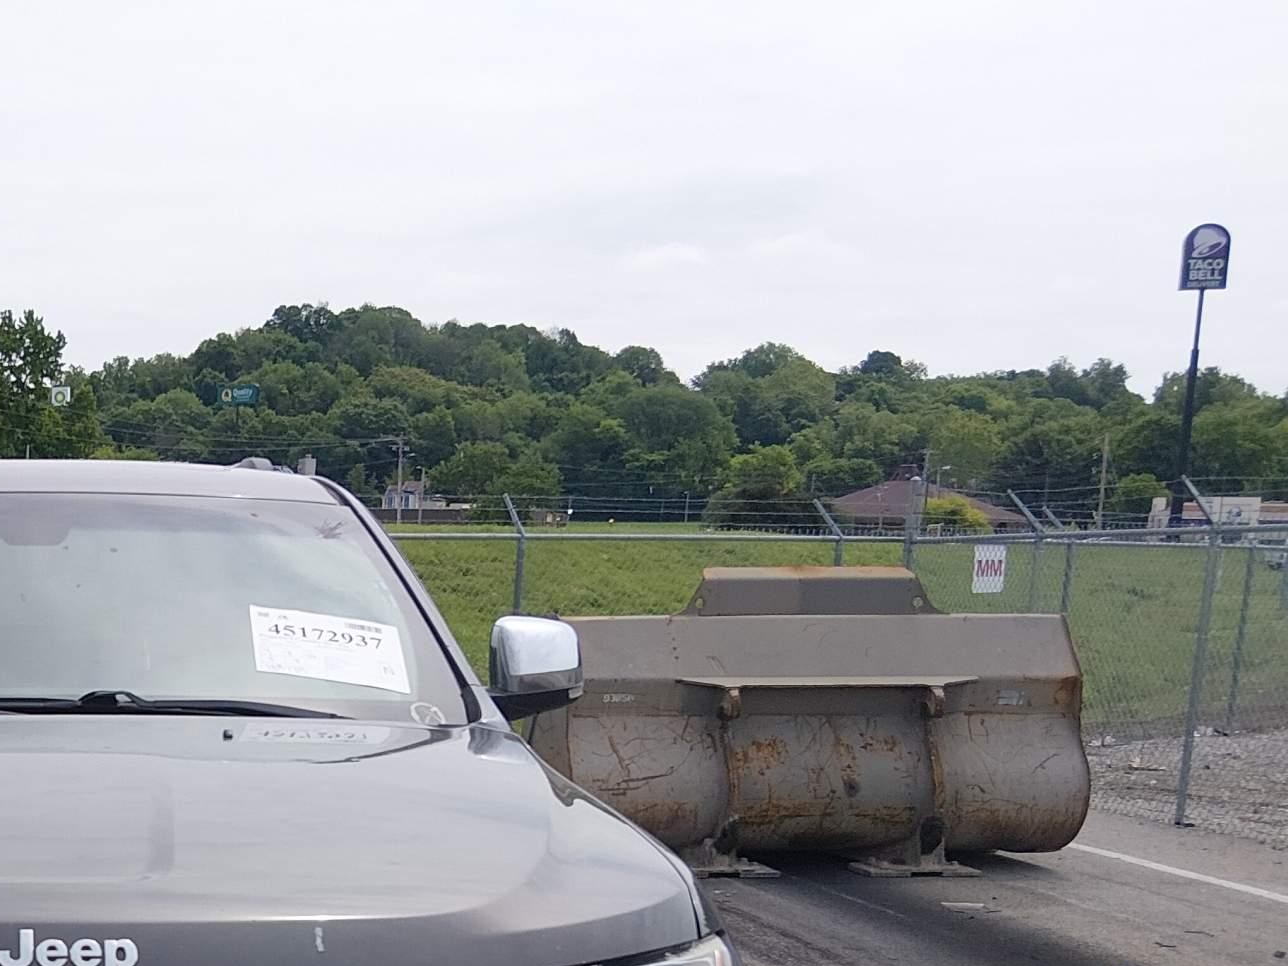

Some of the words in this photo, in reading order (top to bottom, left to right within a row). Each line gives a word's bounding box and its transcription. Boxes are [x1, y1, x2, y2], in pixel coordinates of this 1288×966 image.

[1188, 259, 1224, 270] TACO
[1189, 270, 1223, 280] BELL
[976, 559, 1003, 577] MM
[268, 623, 383, 650] 45172937
